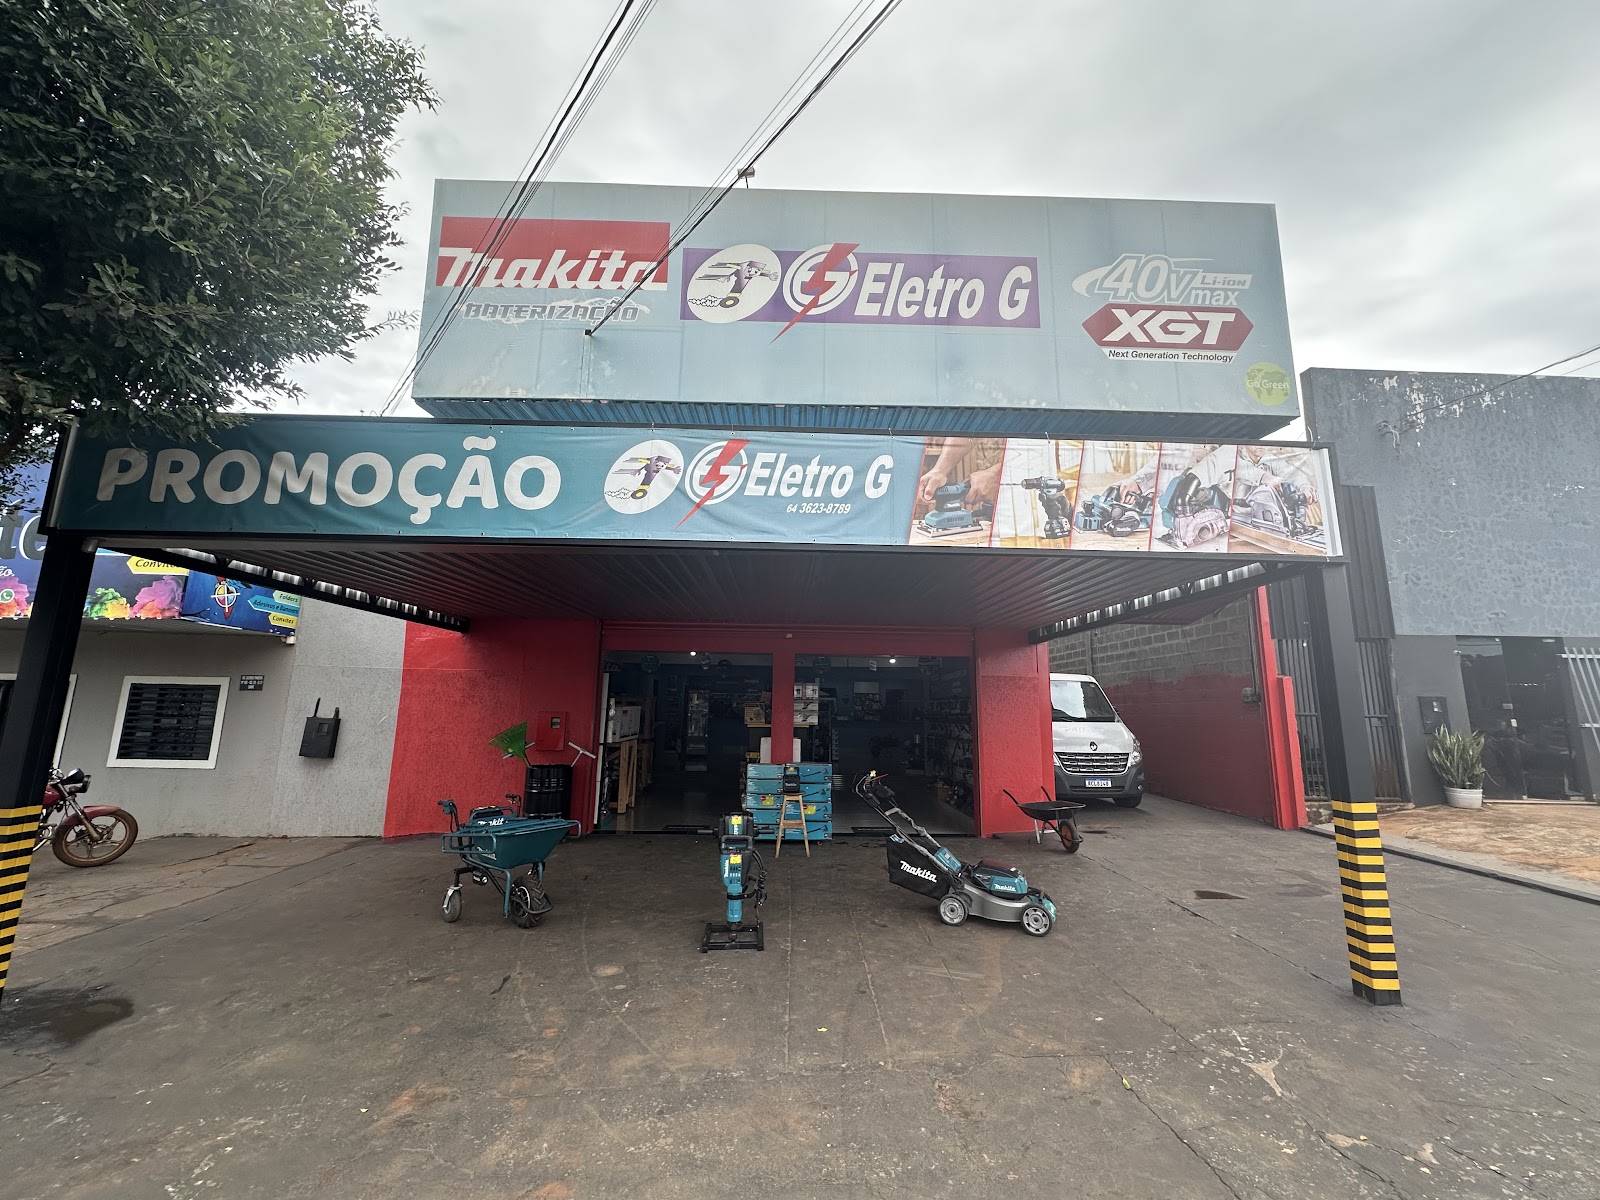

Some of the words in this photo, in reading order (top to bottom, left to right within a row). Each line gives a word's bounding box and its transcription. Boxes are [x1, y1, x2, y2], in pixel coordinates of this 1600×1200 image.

[854, 262, 985, 320] Eletro
[998, 265, 1032, 321] G
[1190, 288, 1240, 306] max
[1101, 308, 1237, 345] XGT
[1108, 349, 1129, 359] Next
[1131, 350, 1180, 361] Generation
[1181, 352, 1234, 364] Technology
[1261, 380, 1289, 389] Green
[96, 435, 562, 525] PROMOÇÃO
[744, 452, 854, 499] Eletro
[864, 454, 894, 500] G
[786, 504, 797, 514] 64
[798, 502, 852, 515] 3623-8789
